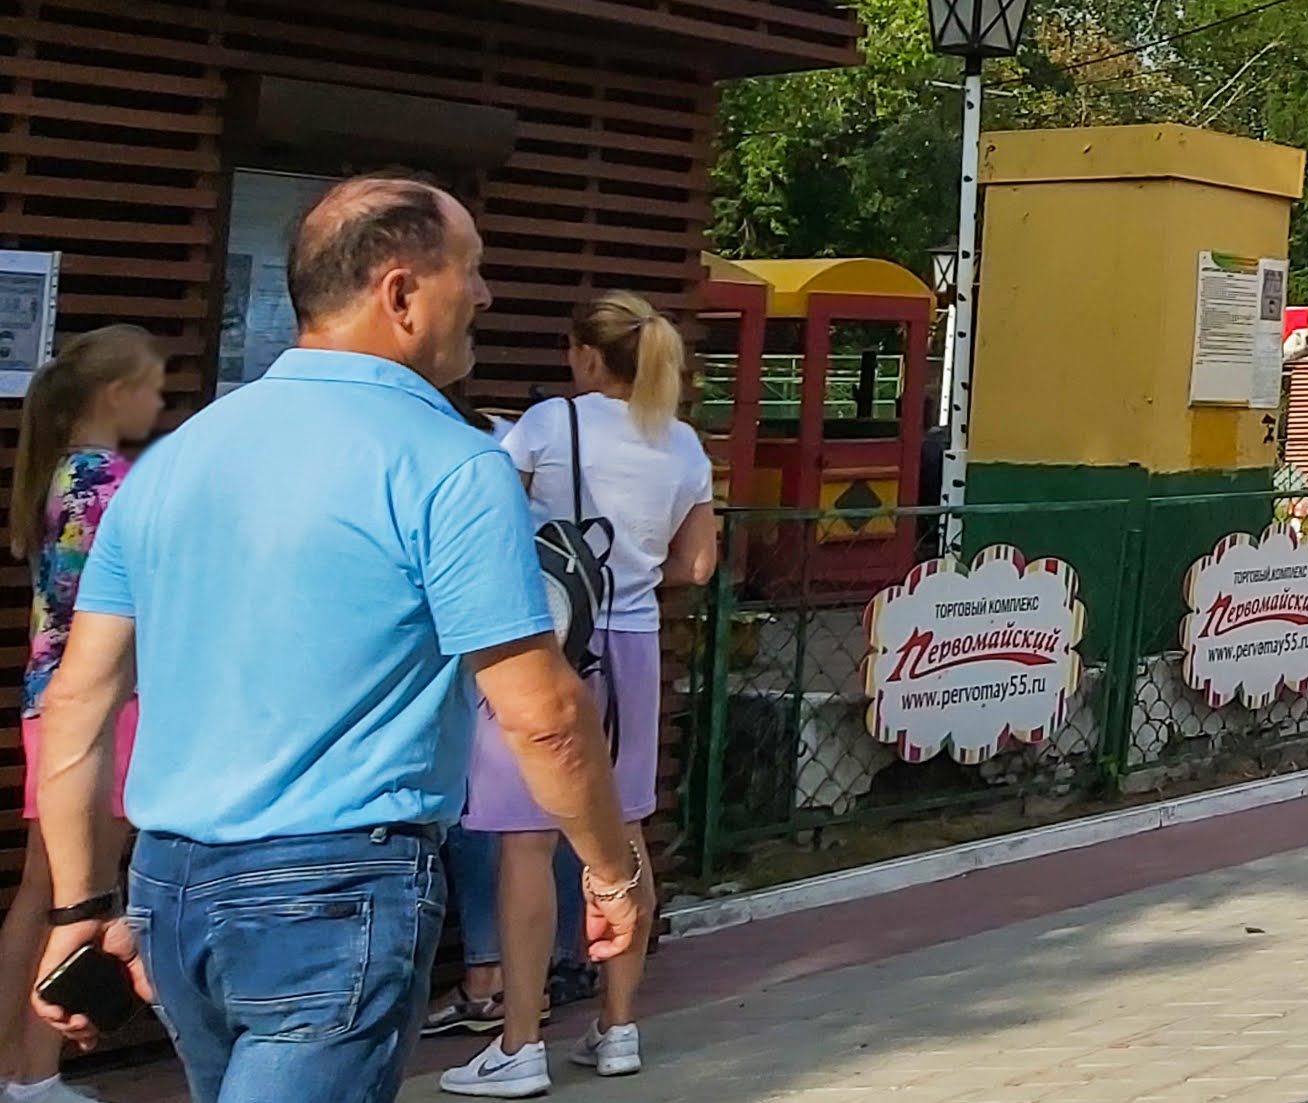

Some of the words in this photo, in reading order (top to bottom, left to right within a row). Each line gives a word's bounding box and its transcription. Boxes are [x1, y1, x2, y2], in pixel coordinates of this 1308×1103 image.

[1234, 566, 1270, 584] ТОРГОВЫЙ
[935, 597, 987, 618] ТОРГОВЫЙ
[989, 596, 1040, 614] КОМПЛЕКС
[886, 620, 1061, 682] Первомайский
[901, 673, 1046, 711] www.pervomay55.ru
